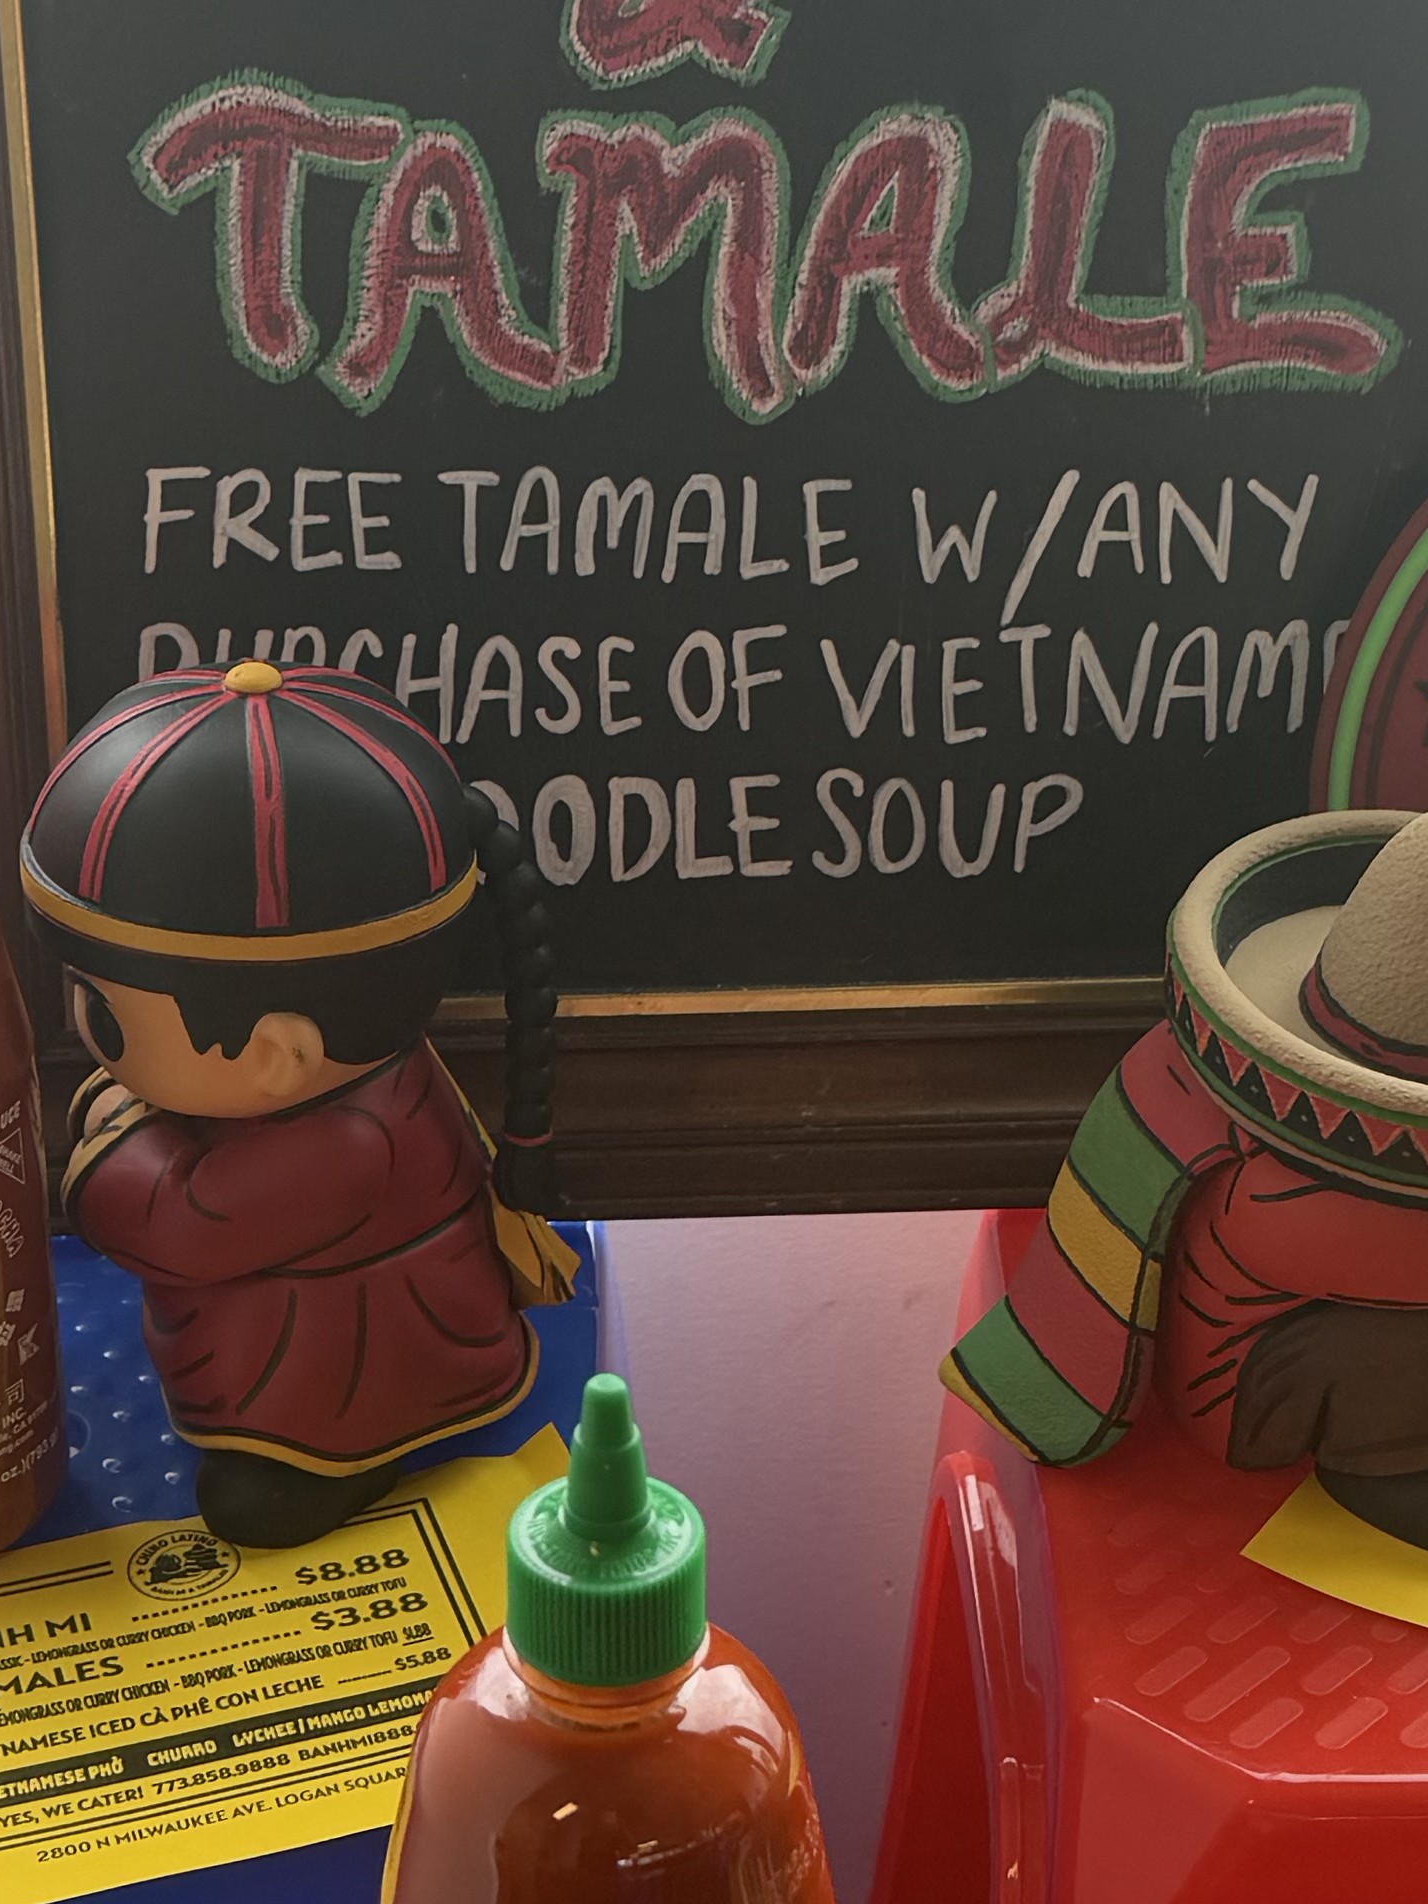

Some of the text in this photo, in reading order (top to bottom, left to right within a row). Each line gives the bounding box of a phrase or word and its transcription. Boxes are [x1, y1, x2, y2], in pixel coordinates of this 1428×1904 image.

[129, 65, 1402, 426] TAMALE
[141, 466, 403, 576] FREE
[438, 464, 860, 586] TAMALE
[668, 621, 783, 734] OF
[813, 771, 1083, 879] SOUP
[44, 1612, 93, 1638] MI
[295, 1548, 410, 1586] $8.88
[205, 1613, 227, 1628] BBQ
[227, 1606, 256, 1622] PORK
[310, 1592, 428, 1632] $3.88
[65, 1696, 84, 1712] OR
[83, 1687, 121, 1708] CURRY
[121, 1679, 171, 1700] CHICKEN
[180, 1670, 206, 1689] BBQ
[205, 1664, 237, 1683] PORK
[243, 1649, 315, 1674] LEMONGRASS
[315, 1644, 333, 1659] OR
[332, 1638, 369, 1657] CURRY
[369, 1630, 398, 1649] TOFU
[89, 1717, 135, 1738] ICED
[171, 1696, 213, 1721] PHÊ
[215, 1688, 259, 1710] CON
[262, 1675, 324, 1698] LECHE
[394, 1647, 452, 1671] $5.88
[42, 1802, 74, 1818] WE
[77, 1786, 143, 1811] CATER!
[152, 1753, 291, 1794] 773.858.9888
[147, 1740, 217, 1766] CHURRO
[37, 1767, 408, 1863] 2800 N MILWAUKEE AVE. LOGAN SQUAR
